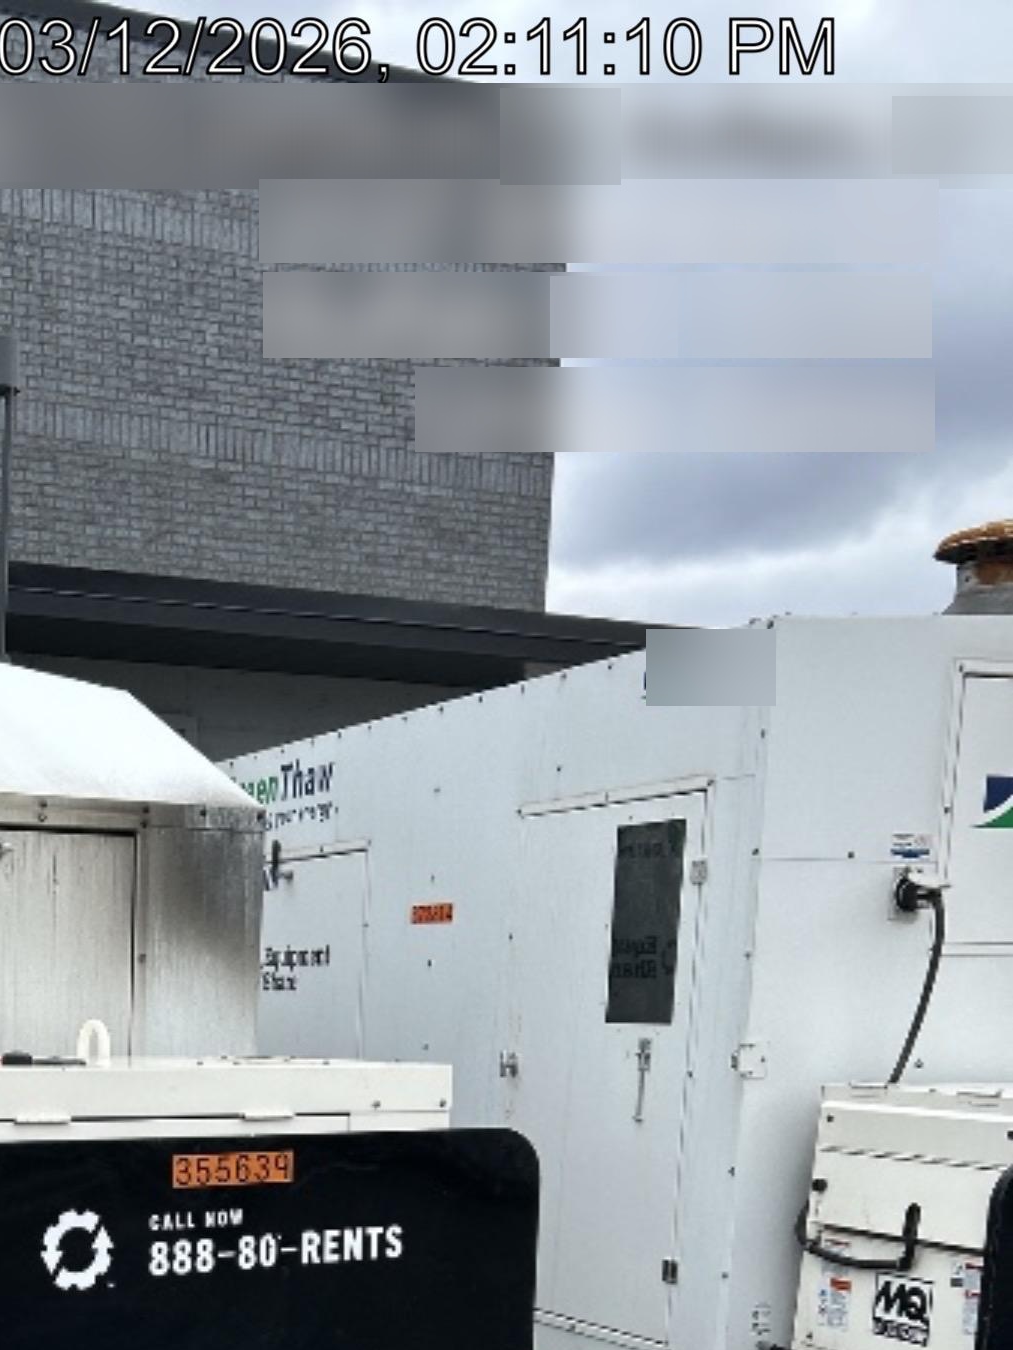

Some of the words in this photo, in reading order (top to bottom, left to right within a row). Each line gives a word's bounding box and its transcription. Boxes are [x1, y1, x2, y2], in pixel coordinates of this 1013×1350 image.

[174, 1153, 290, 1187] 355639
[148, 1211, 196, 1231] CALL
[205, 1208, 244, 1229] NOW
[148, 1223, 403, 1277] 888-80-RENTS
[874, 1280, 928, 1322] MQ
